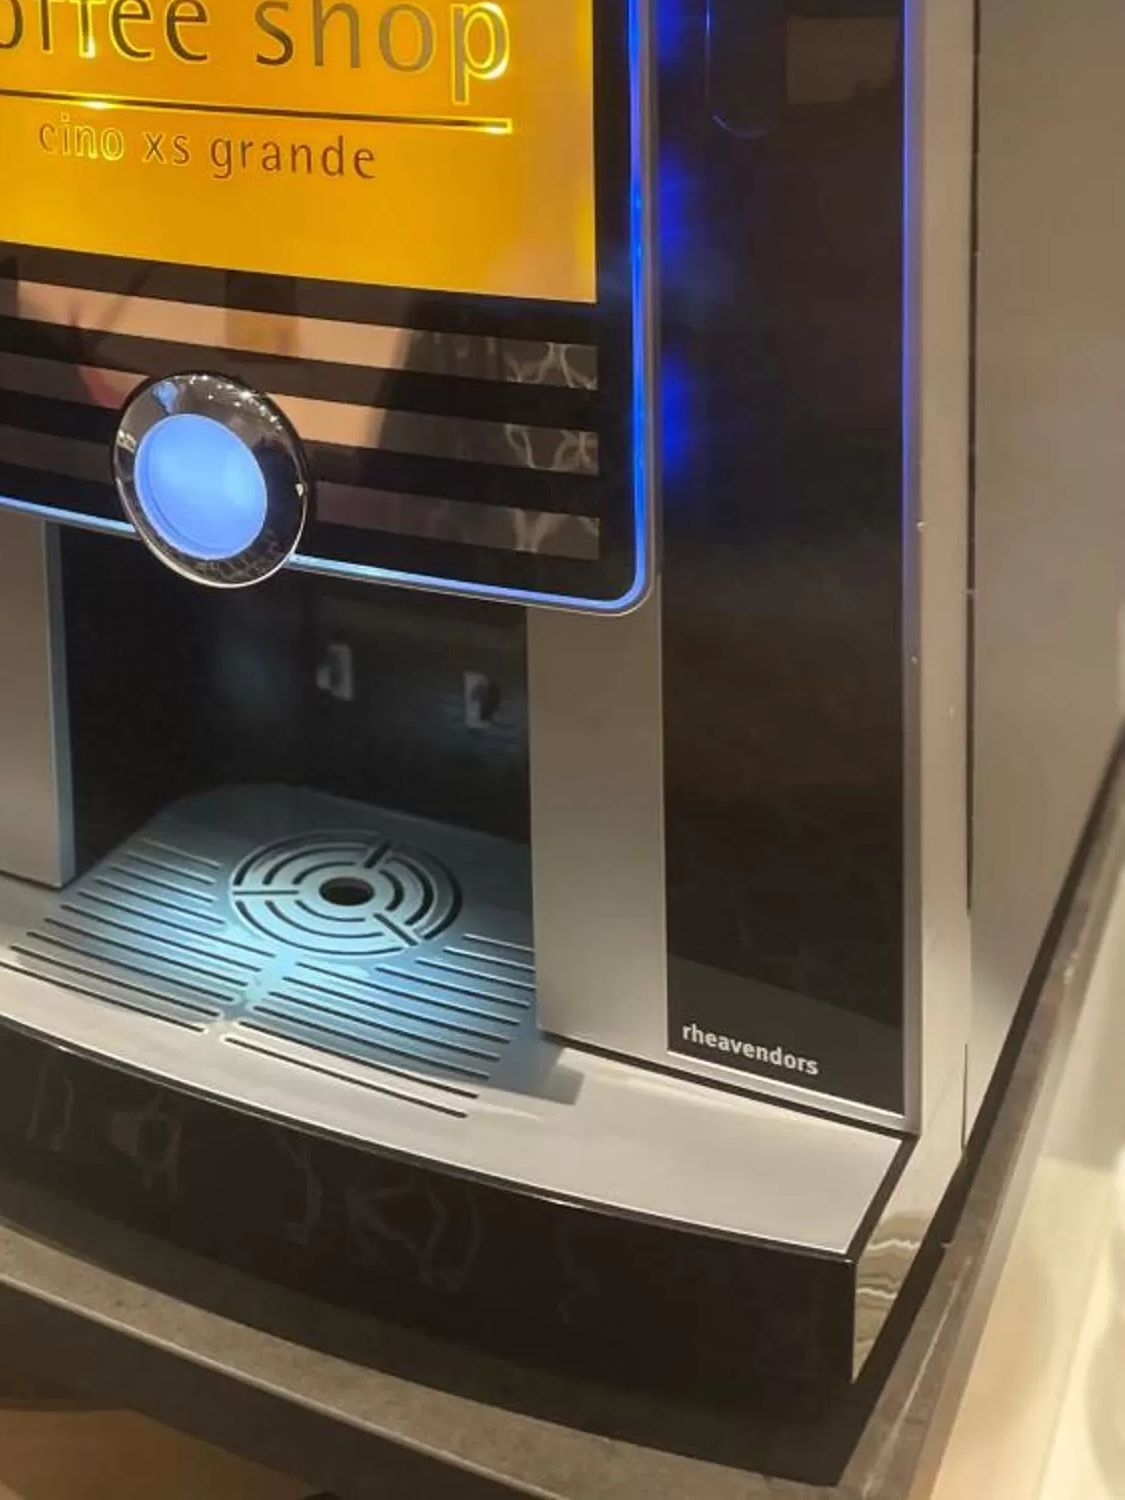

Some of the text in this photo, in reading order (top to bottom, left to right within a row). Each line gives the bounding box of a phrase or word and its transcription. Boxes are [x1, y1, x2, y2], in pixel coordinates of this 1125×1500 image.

[39, 111, 376, 180] cino xs grande
[682, 1022, 820, 1076] rheavendors
